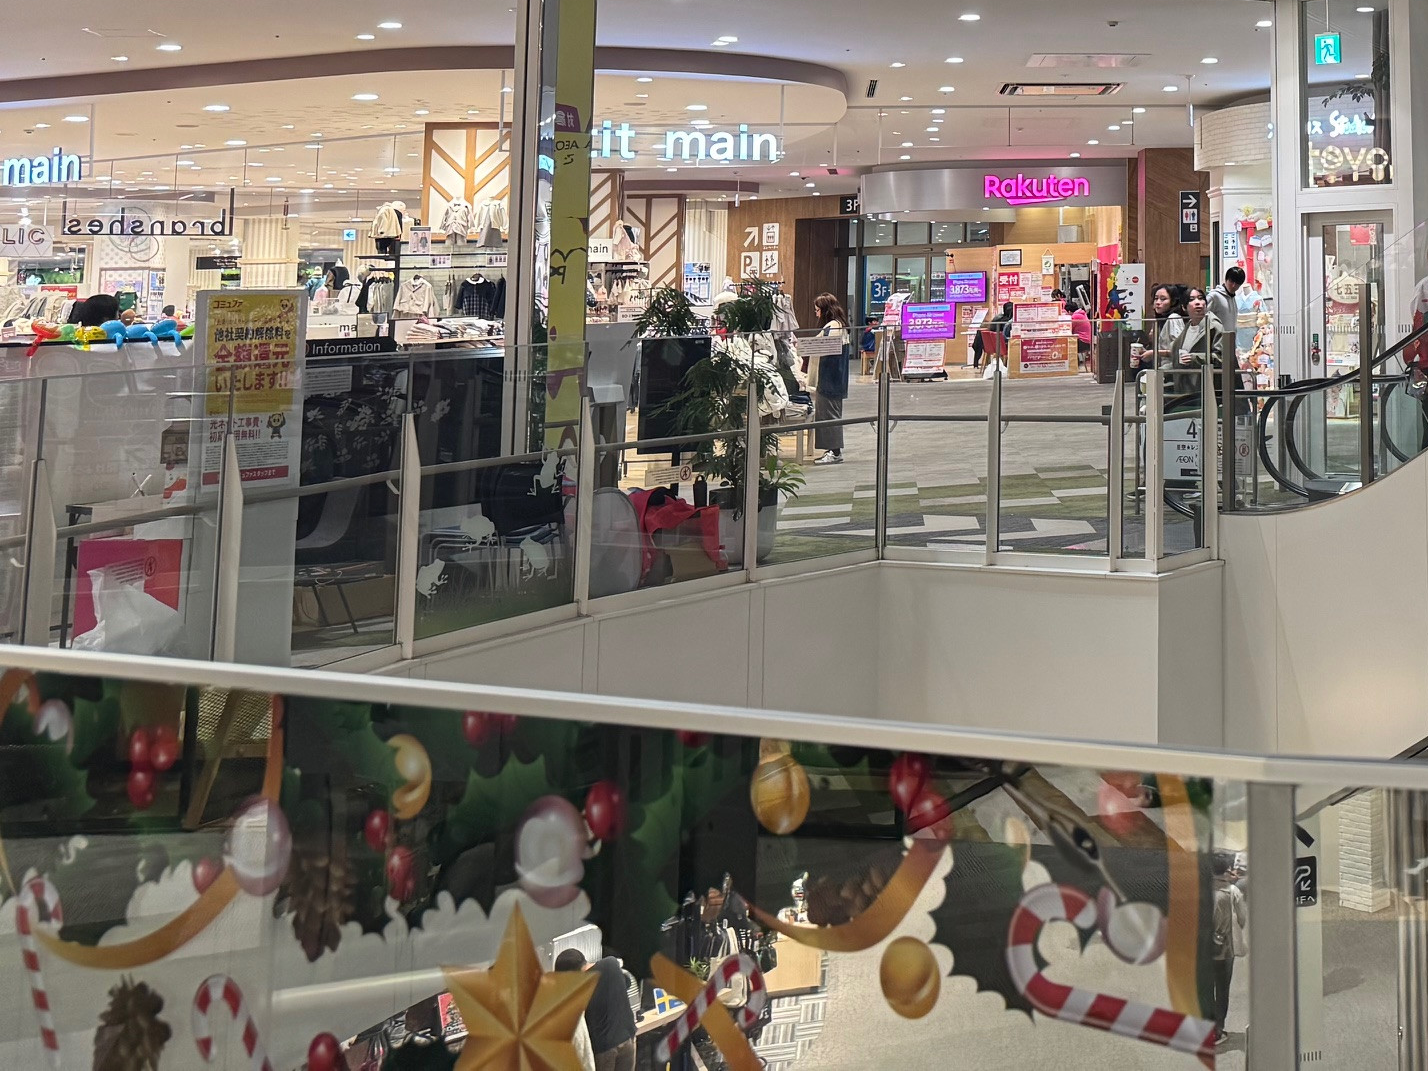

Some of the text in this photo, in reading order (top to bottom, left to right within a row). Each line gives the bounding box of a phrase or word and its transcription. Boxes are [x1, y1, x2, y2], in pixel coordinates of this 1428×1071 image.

[664, 123, 778, 161] main
[3, 146, 82, 186] main
[984, 173, 1091, 200] Rakuten
[1000, 274, 1018, 286] 受付
[214, 326, 291, 344] 他社契約解除料を
[312, 340, 381, 355] Information
